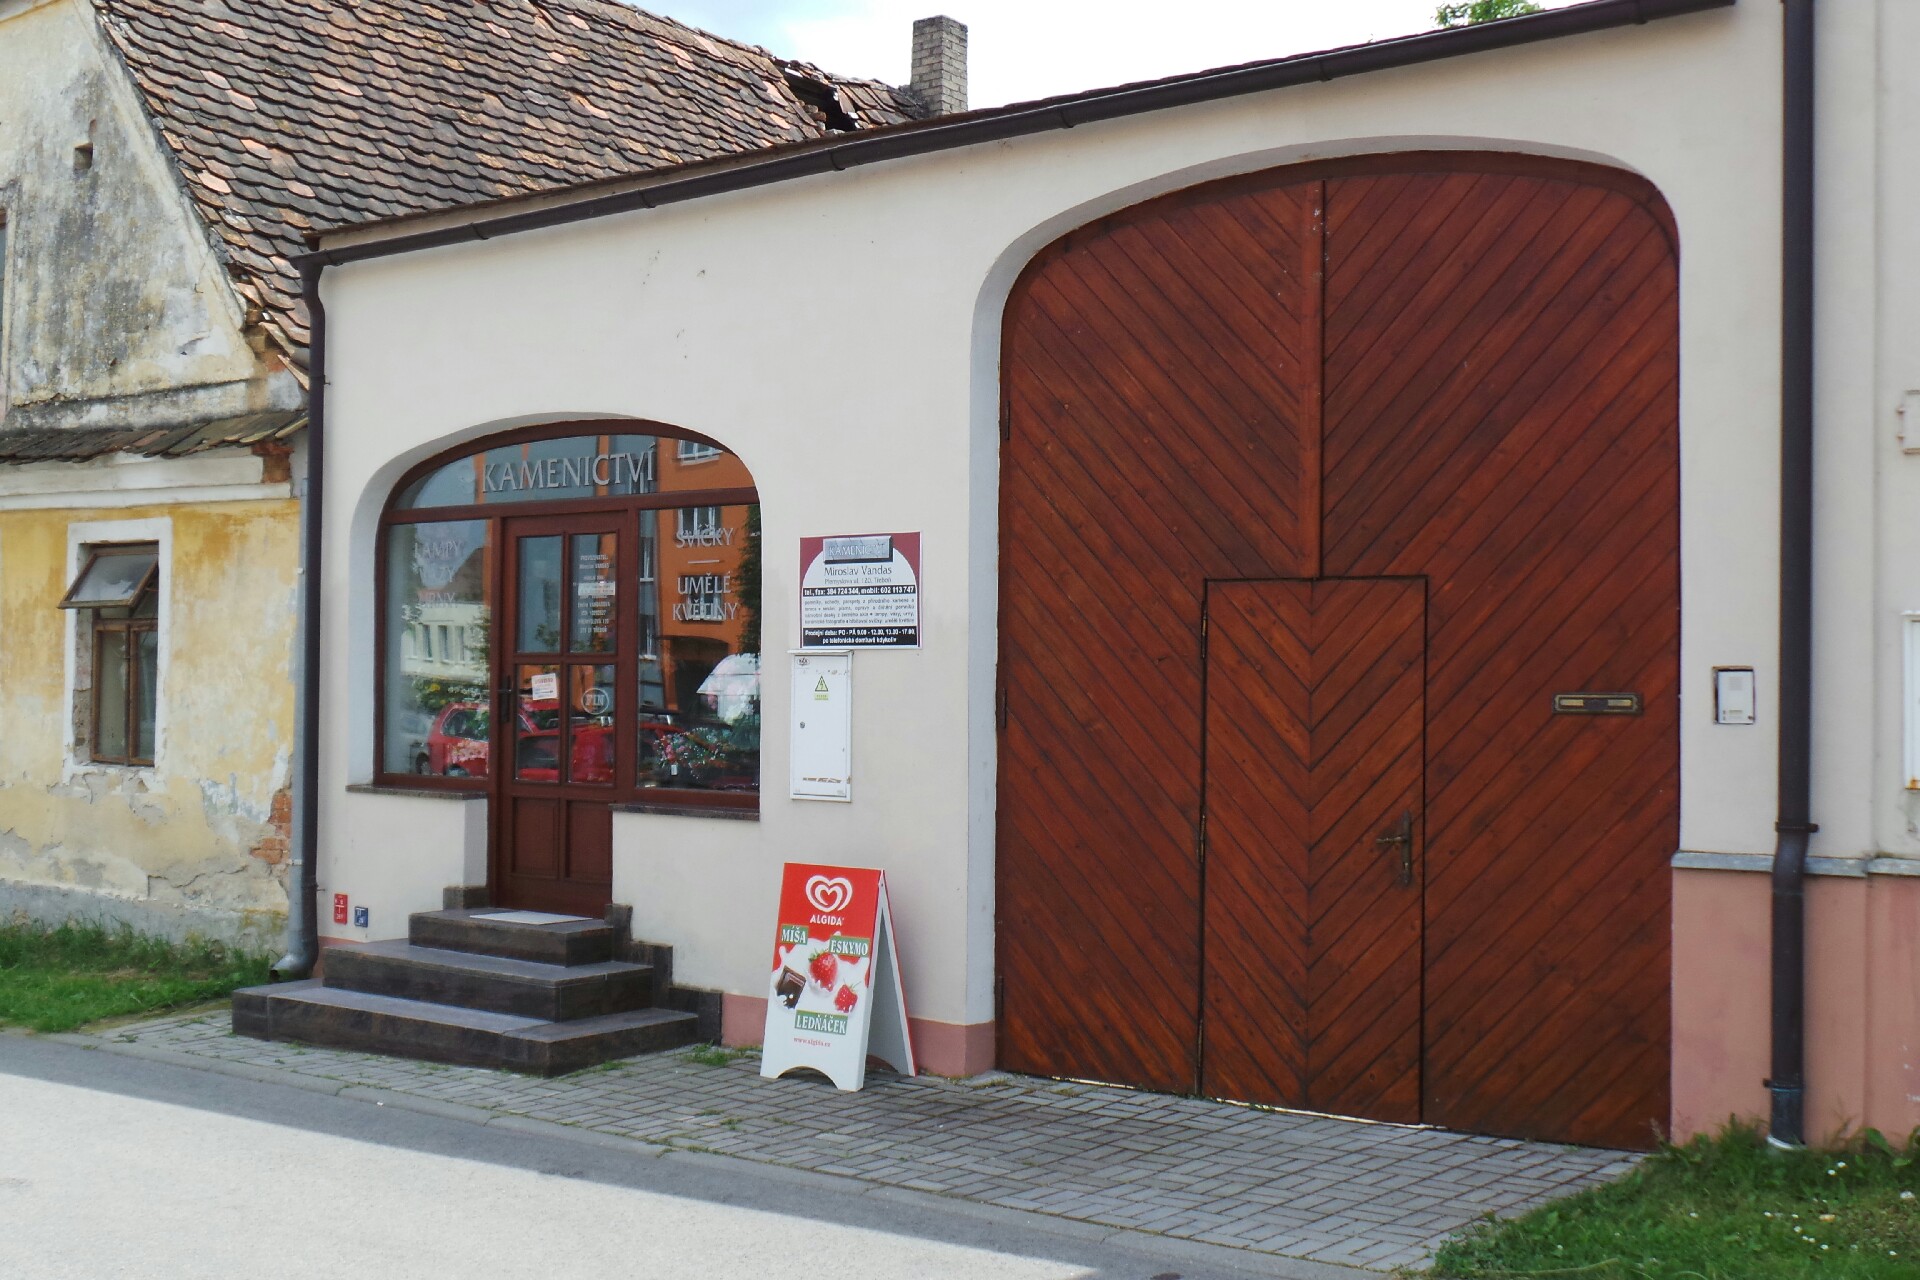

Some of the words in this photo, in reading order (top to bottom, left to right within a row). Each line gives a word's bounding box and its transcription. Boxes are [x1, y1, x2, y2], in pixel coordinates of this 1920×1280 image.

[482, 442, 657, 493] KAMENICTVÍ
[676, 523, 734, 548] SVÍČKY
[414, 539, 463, 559] LAMPY
[824, 567, 858, 576] Miroslav
[861, 565, 892, 575] Vandas
[677, 571, 732, 595] UMĚLÉ
[672, 599, 738, 621] KVĚTINY
[810, 914, 843, 926] ALGIDA
[781, 926, 806, 944] MÍŠA
[830, 940, 869, 956] ESKYMO
[796, 1014, 846, 1034] LEDŇÁČEK
